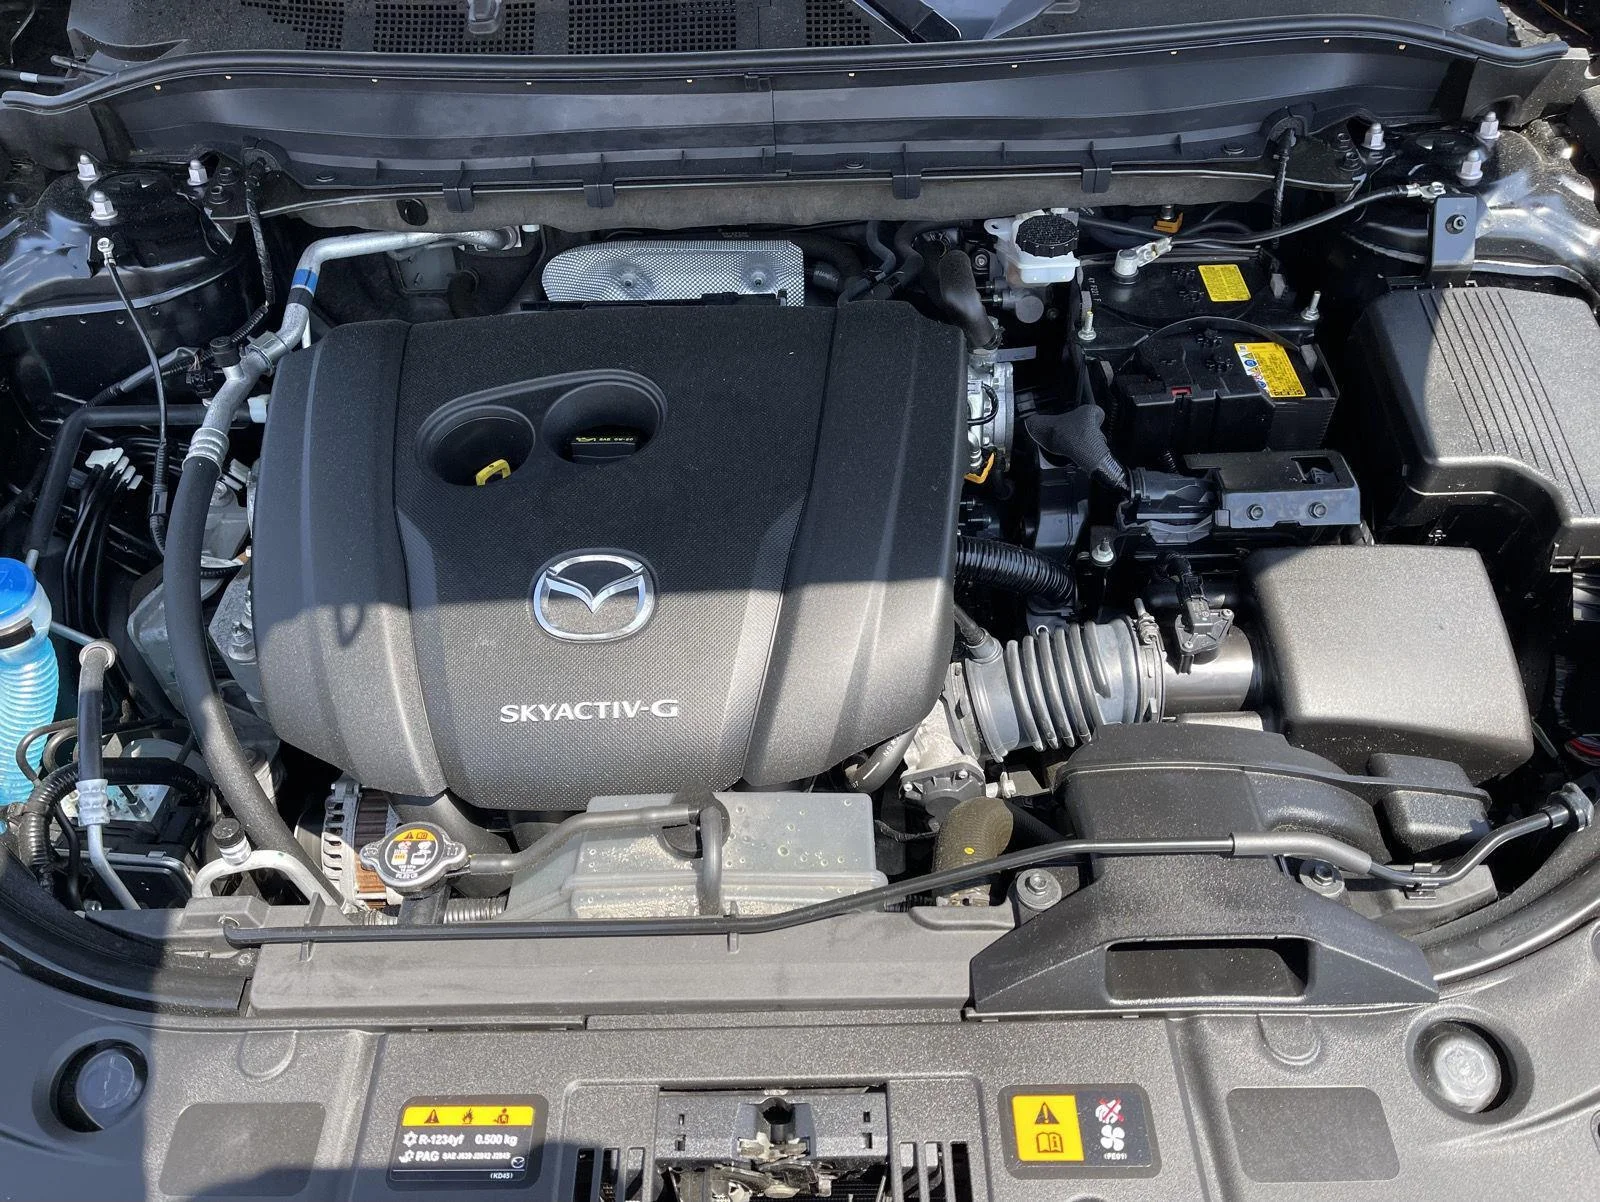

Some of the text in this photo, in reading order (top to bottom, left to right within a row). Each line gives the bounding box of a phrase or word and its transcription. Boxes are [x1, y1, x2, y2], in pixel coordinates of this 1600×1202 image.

[500, 699, 679, 723] SKYACTIV-G
[418, 1133, 519, 1147] R-1234yf 0.500 kg
[415, 1151, 440, 1161] PAG
